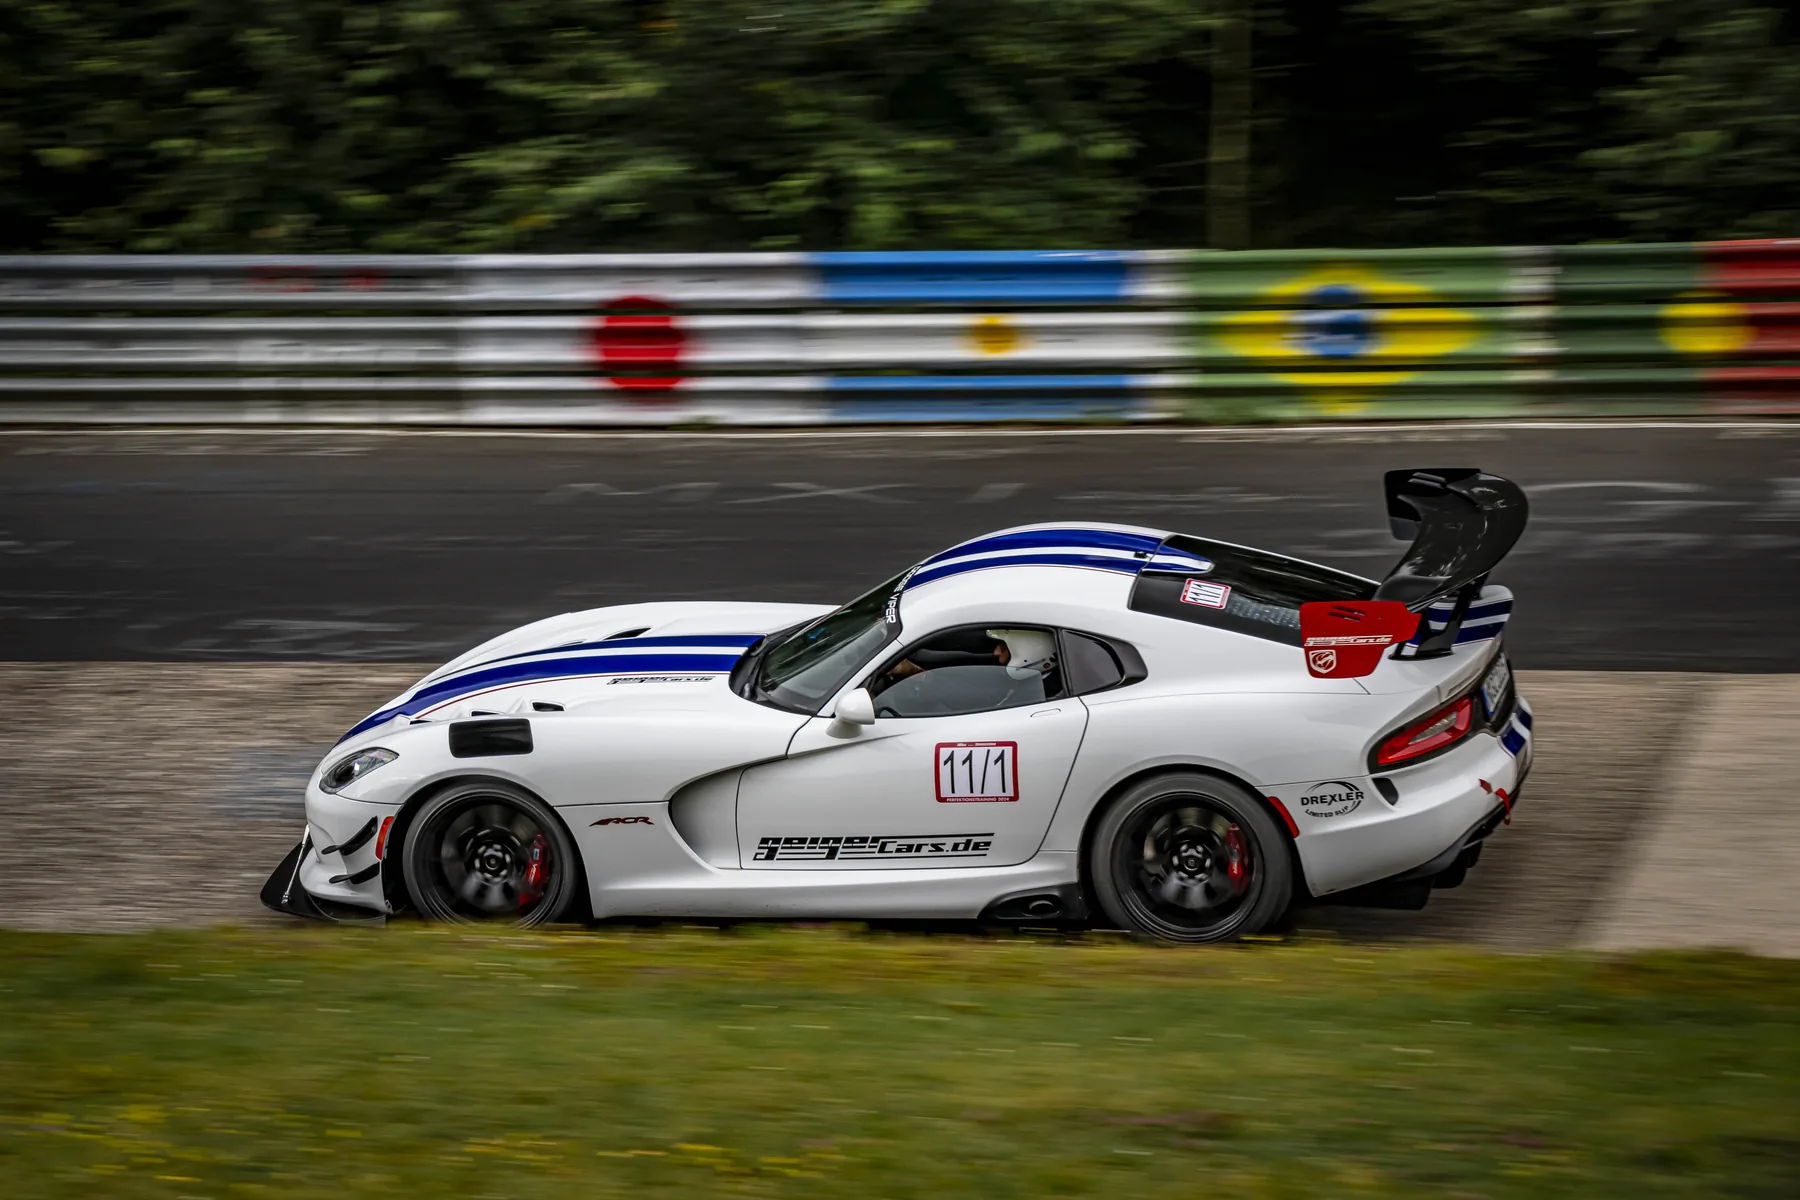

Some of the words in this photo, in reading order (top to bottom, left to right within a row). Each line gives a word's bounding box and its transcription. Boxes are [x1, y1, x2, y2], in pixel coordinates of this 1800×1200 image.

[1187, 582, 1223, 604] 11/1
[886, 593, 900, 623] VIPER
[943, 749, 1006, 794] 11/1
[1301, 792, 1364, 806] DREXLER
[1305, 808, 1333, 817] LIMITED
[1335, 805, 1349, 816] SLIP
[596, 816, 655, 826] ACR
